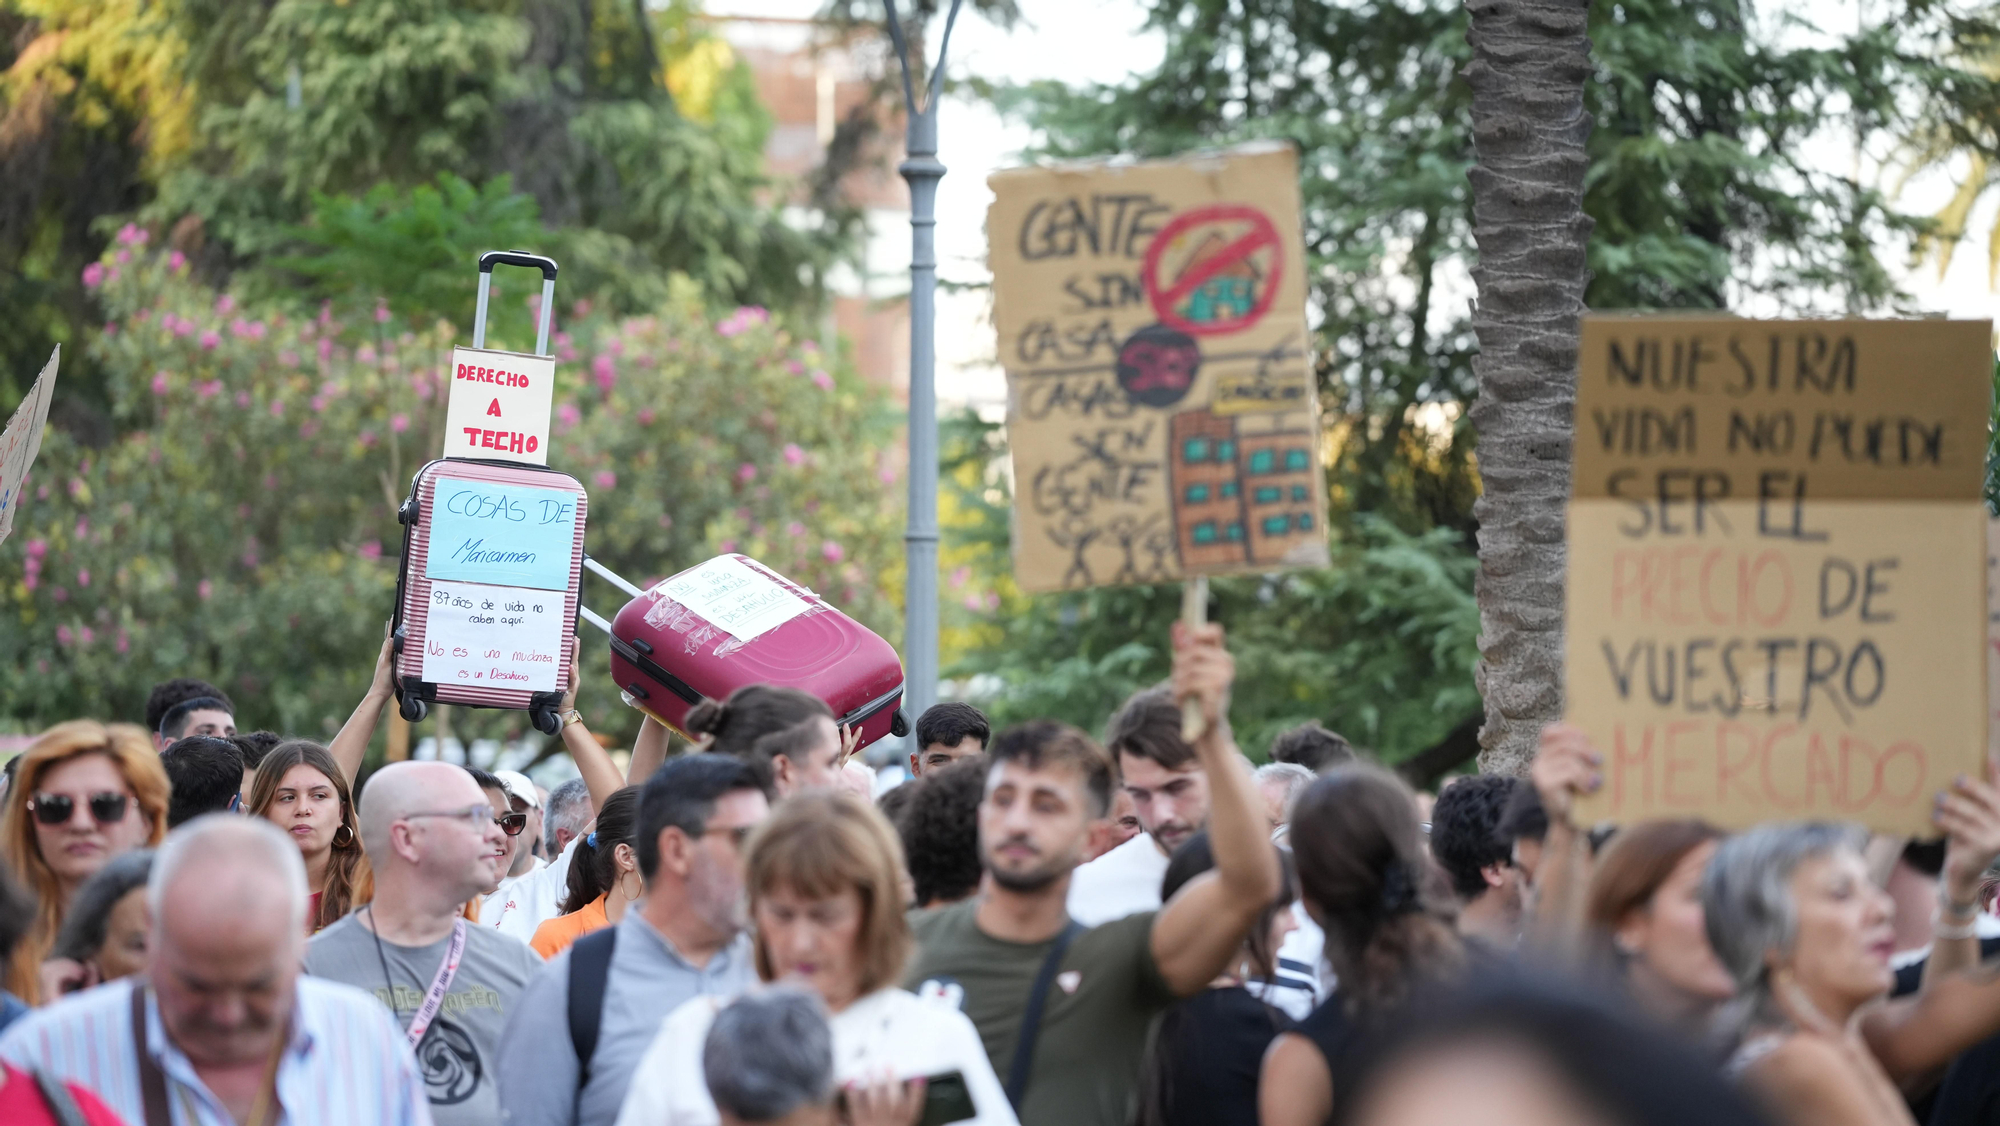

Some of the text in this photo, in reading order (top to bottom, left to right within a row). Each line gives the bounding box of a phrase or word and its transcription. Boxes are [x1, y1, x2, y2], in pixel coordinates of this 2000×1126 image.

[1016, 317, 1123, 365] CASA
[457, 363, 529, 388] DERECHO
[1607, 332, 1857, 394] NUESTRA
[486, 398, 501, 417] A
[463, 427, 538, 454] TECHO
[1592, 406, 1961, 468] VIDA NO PUEDE
[447, 490, 573, 525] COSAS DE
[1605, 467, 1831, 542] SER EL
[451, 537, 537, 564] Maricarmen
[433, 590, 544, 614] 87 años de vida no
[669, 581, 690, 594] NO
[1609, 546, 1901, 629] PRECIO DE
[468, 613, 495, 625] caben
[718, 587, 785, 624] DESAHUCIO
[427, 639, 553, 664] No es una mudanza
[457, 667, 529, 682] es un Desahucio
[1600, 637, 1888, 726] VUESTRO
[1610, 719, 1929, 814] MERCADO
